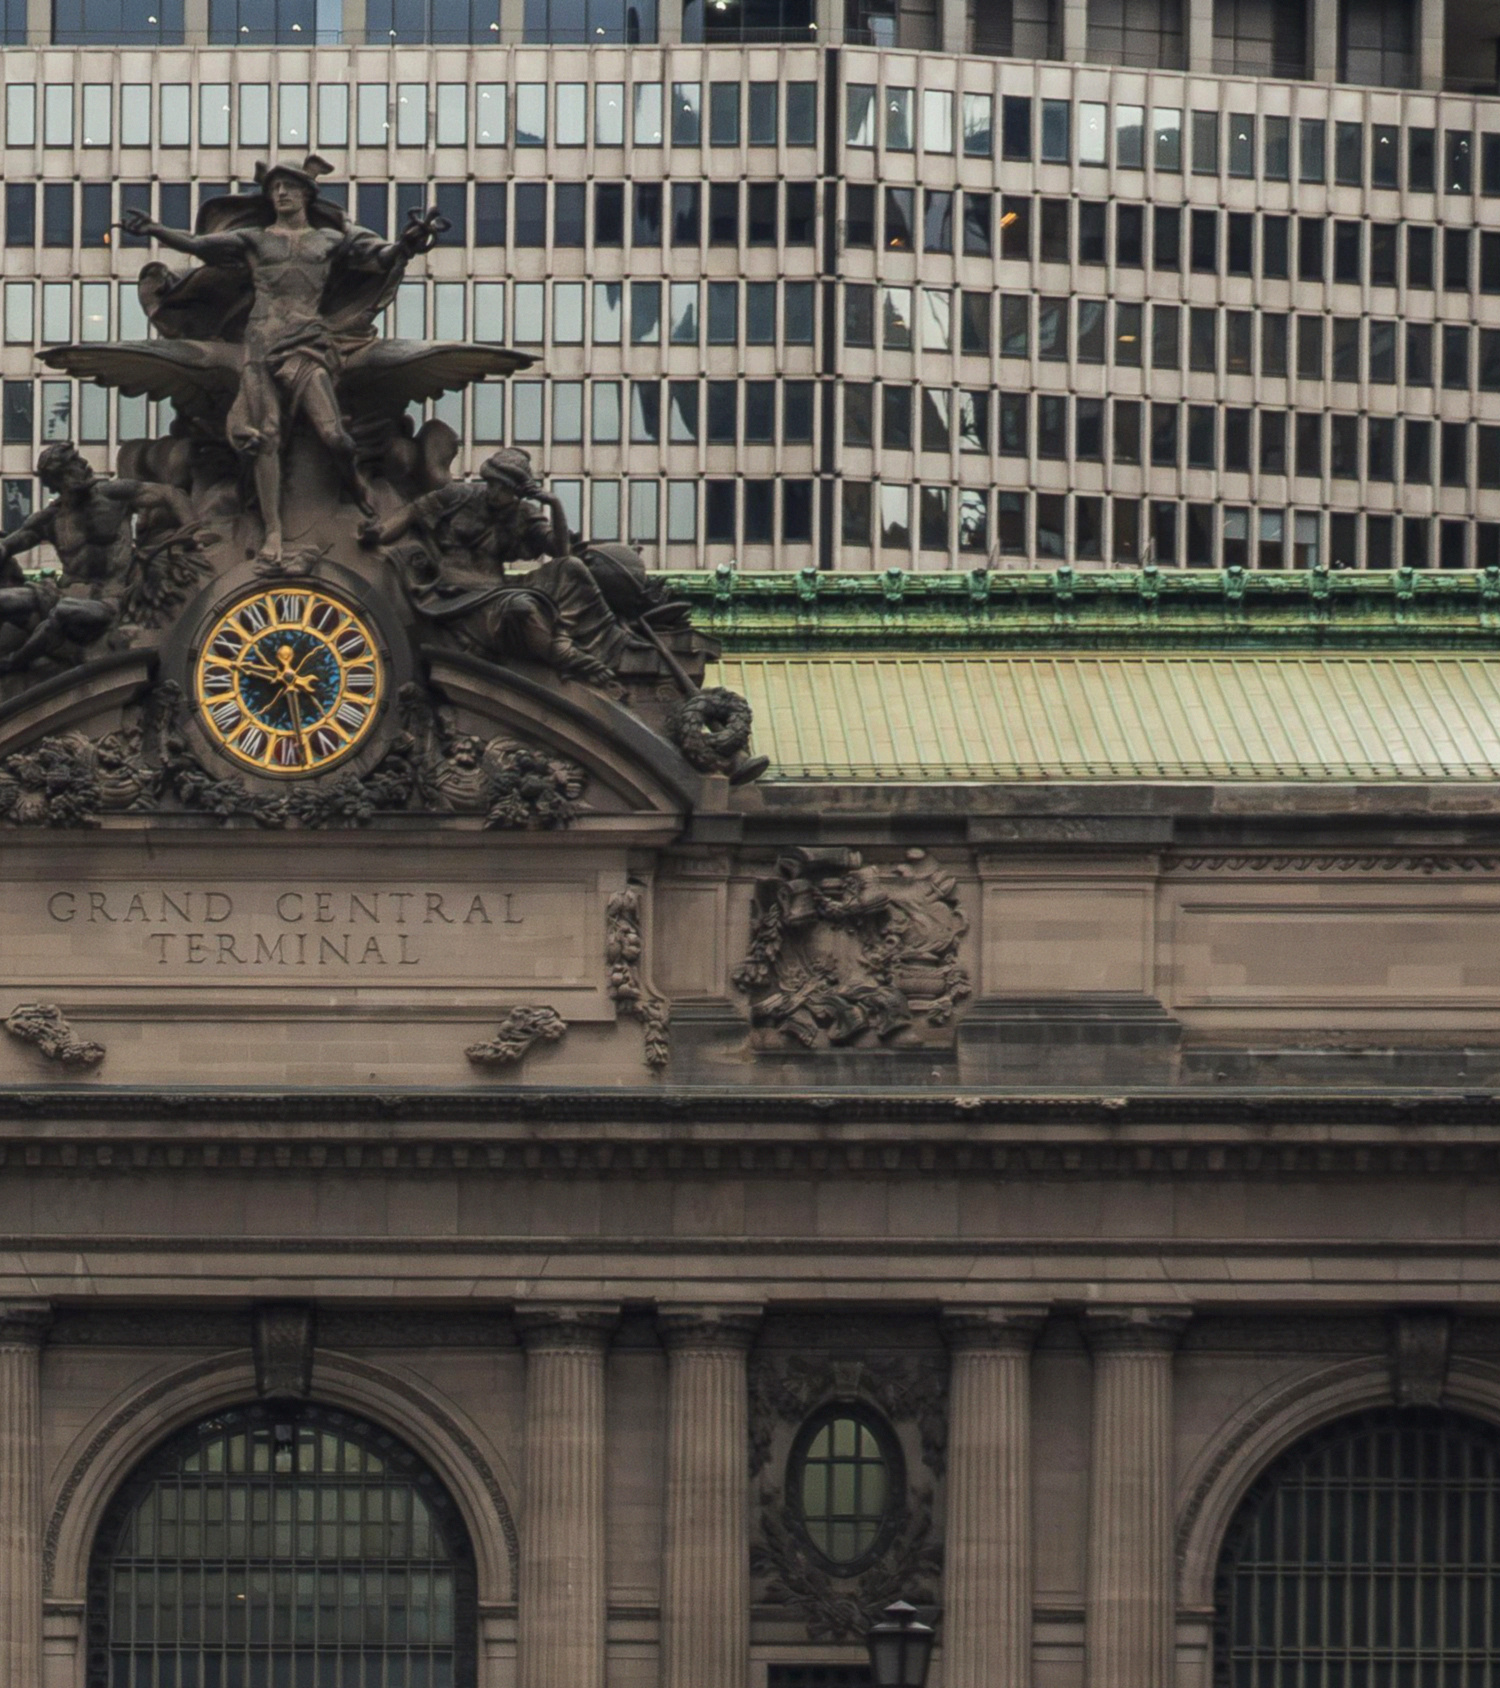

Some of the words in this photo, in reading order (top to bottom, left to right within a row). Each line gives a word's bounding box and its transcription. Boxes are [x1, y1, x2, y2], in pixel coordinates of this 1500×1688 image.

[242, 604, 267, 634] XI
[281, 594, 302, 623] XII
[213, 633, 243, 656] X
[336, 634, 366, 655] II
[345, 673, 375, 687] III
[47, 891, 234, 924] GRAND
[276, 891, 526, 926] CENTRAL
[149, 932, 421, 966] TERMINAL
